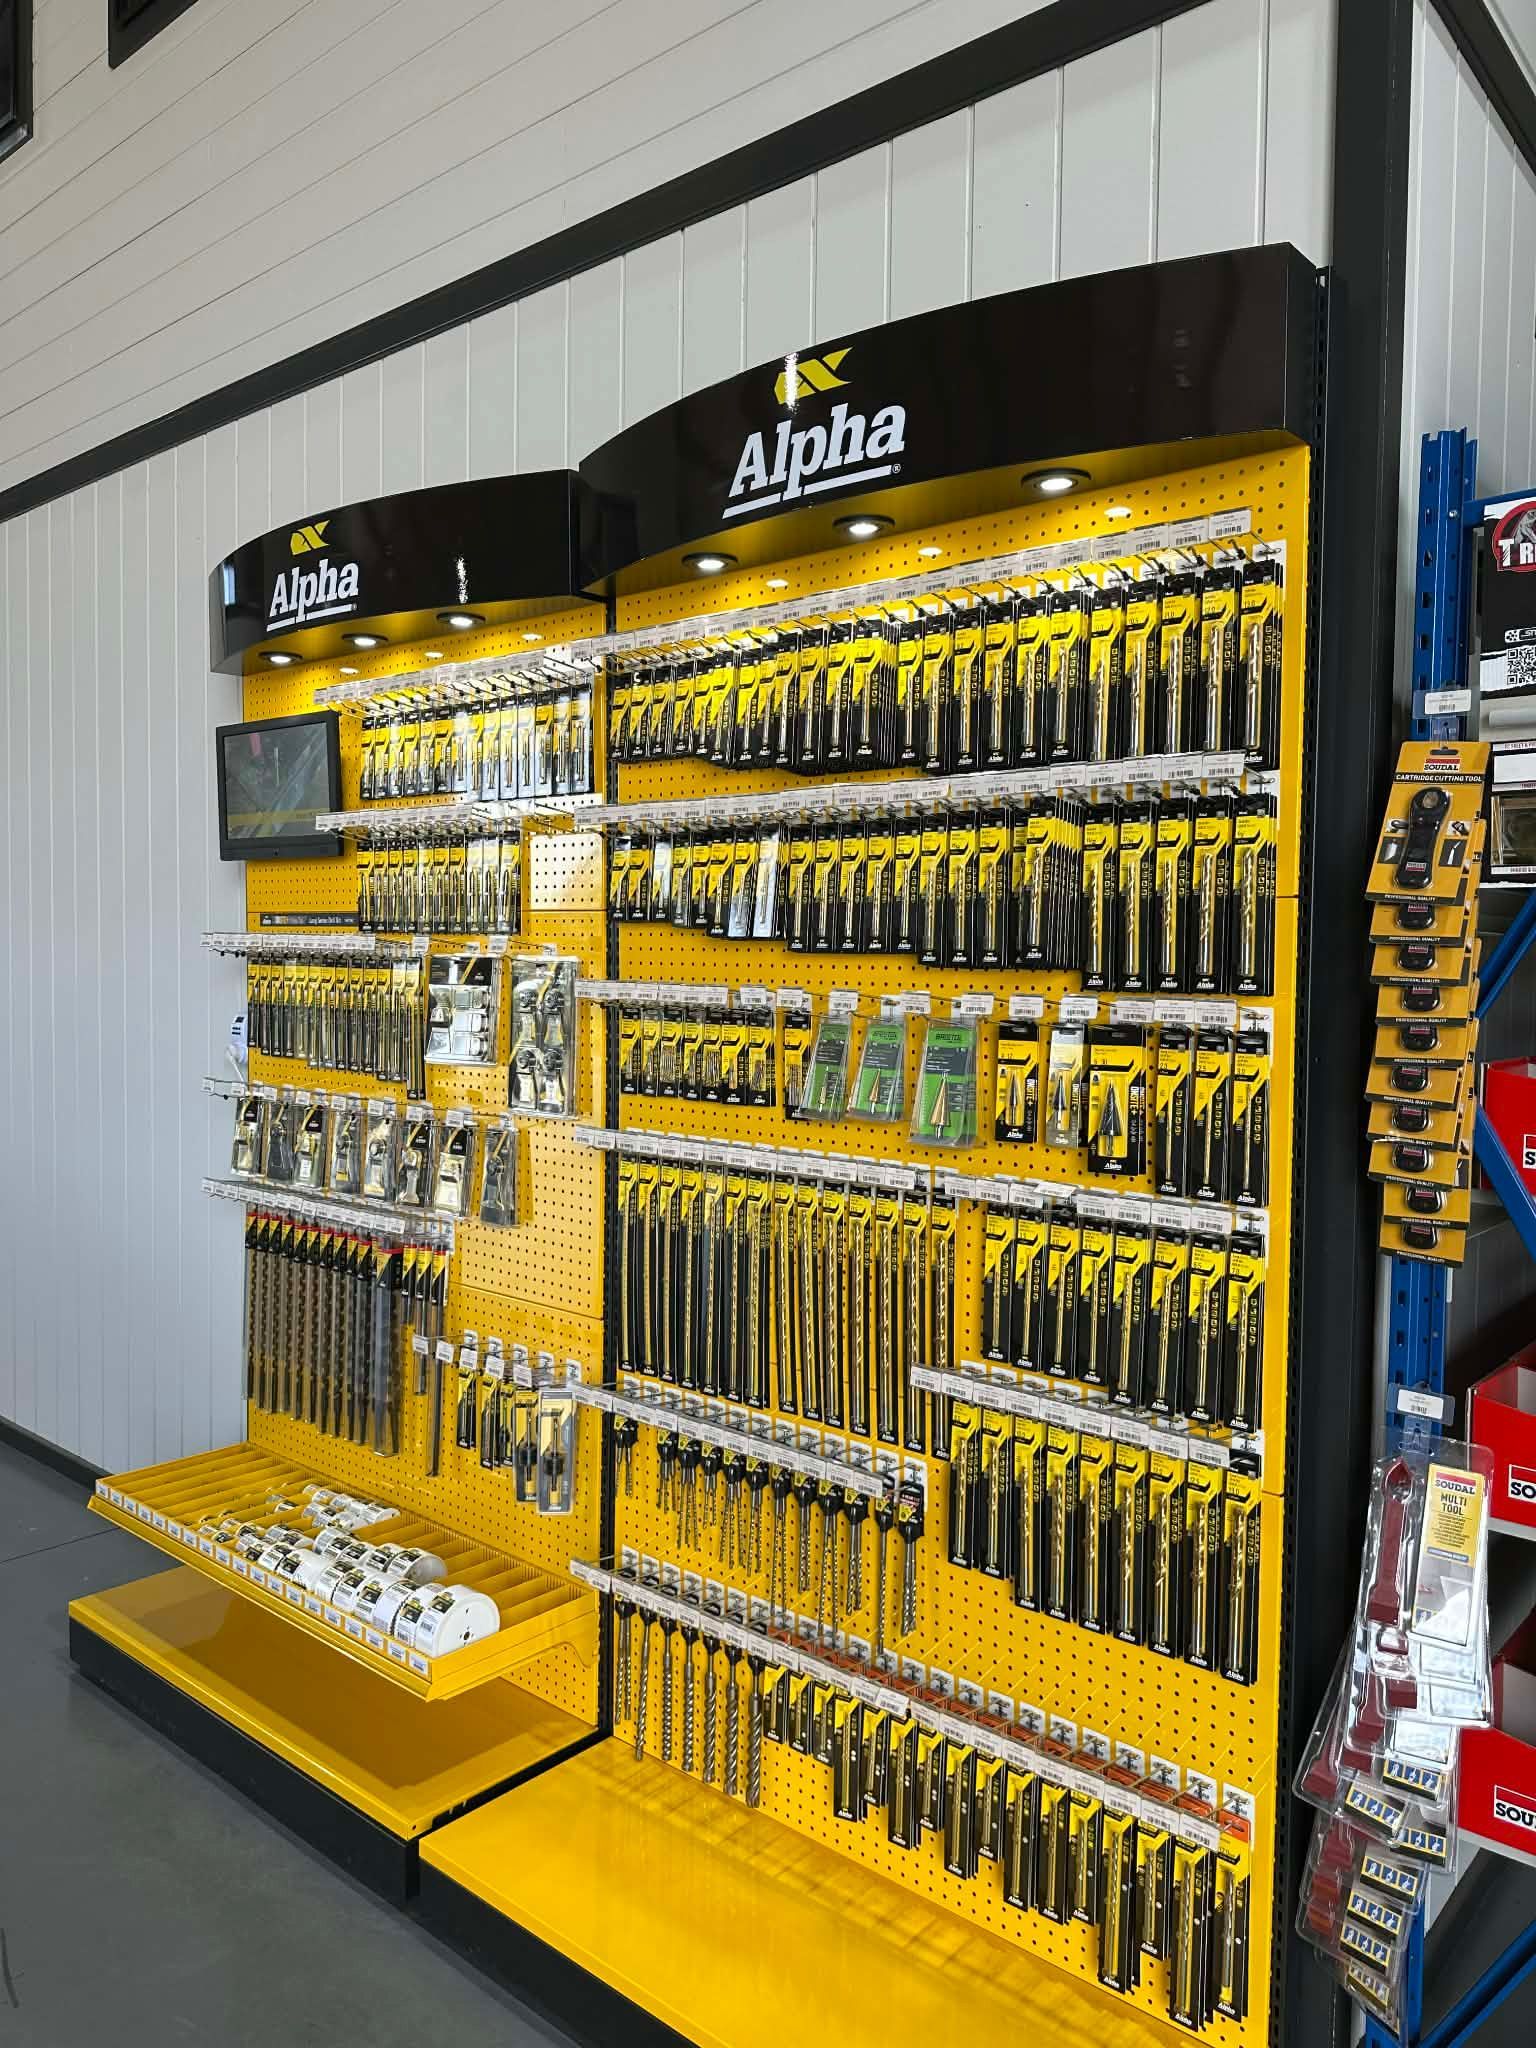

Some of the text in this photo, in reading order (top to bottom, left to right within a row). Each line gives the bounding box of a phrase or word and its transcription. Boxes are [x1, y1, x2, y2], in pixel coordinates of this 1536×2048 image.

[727, 402, 906, 502] Alpha
[1520, 541, 1536, 565] R
[268, 558, 360, 624] Alpha
[1396, 774, 1434, 782] CARTRIDGE
[1435, 1479, 1475, 1495] SOUDAL
[1441, 1493, 1467, 1507] MULTI
[1442, 1503, 1464, 1516] TOOL
[1496, 1803, 1536, 1827] SOU
